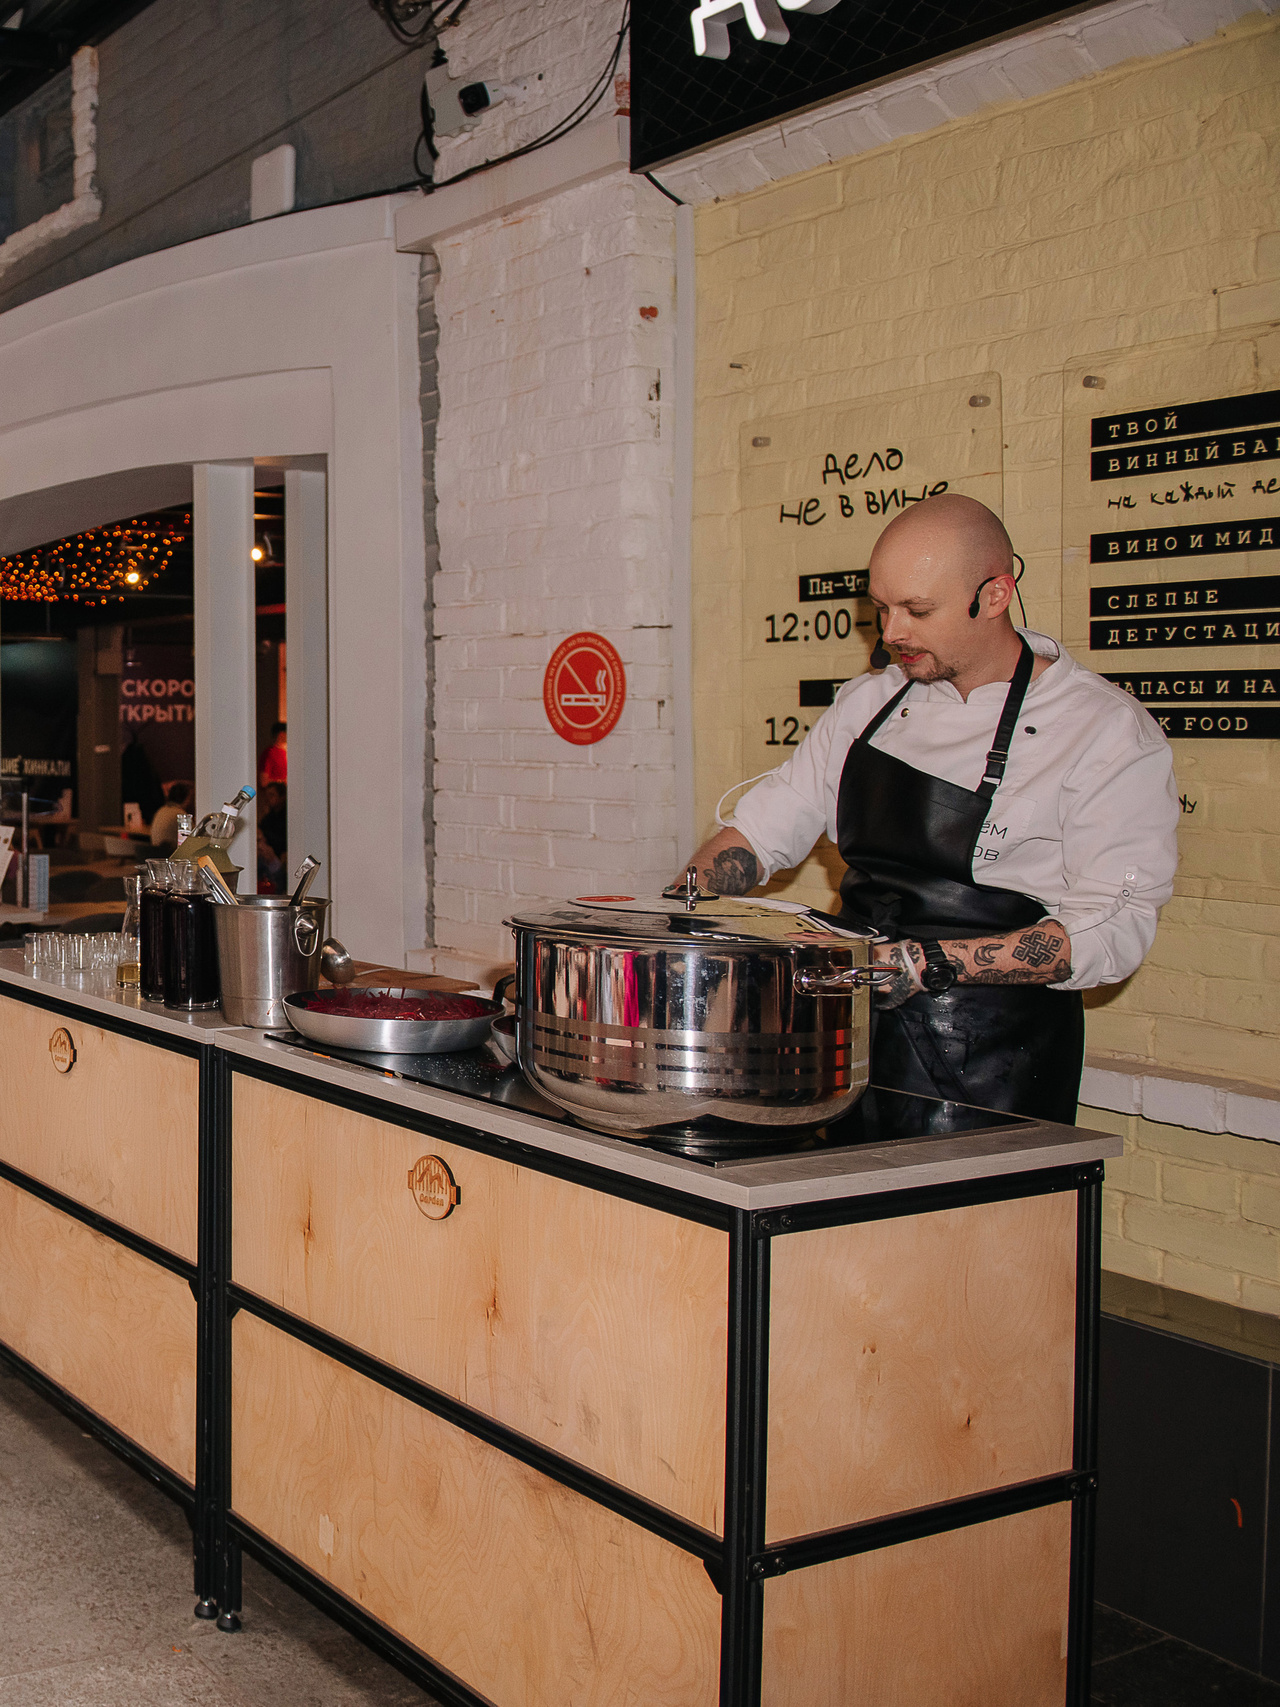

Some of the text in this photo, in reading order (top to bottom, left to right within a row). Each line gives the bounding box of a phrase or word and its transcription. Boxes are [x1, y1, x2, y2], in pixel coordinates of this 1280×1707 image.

[1108, 411, 1178, 438] ТВОЙ
[822, 448, 903, 485] дело
[1108, 441, 1220, 472] ВИННЫЙ
[1108, 494, 1137, 509] на
[1150, 481, 1236, 506] каждый
[779, 498, 826, 526] не
[838, 494, 855, 518] в
[1108, 528, 1273, 555] ВИНО И МИД
[1107, 589, 1219, 609] СЛЕПЫЕ
[1107, 623, 1280, 645] ДЕГУСТАЦИ
[121, 679, 195, 698] СКОРО
[1112, 679, 1276, 695] АПАСЫ И НА
[1184, 717, 1248, 731] FOOD
